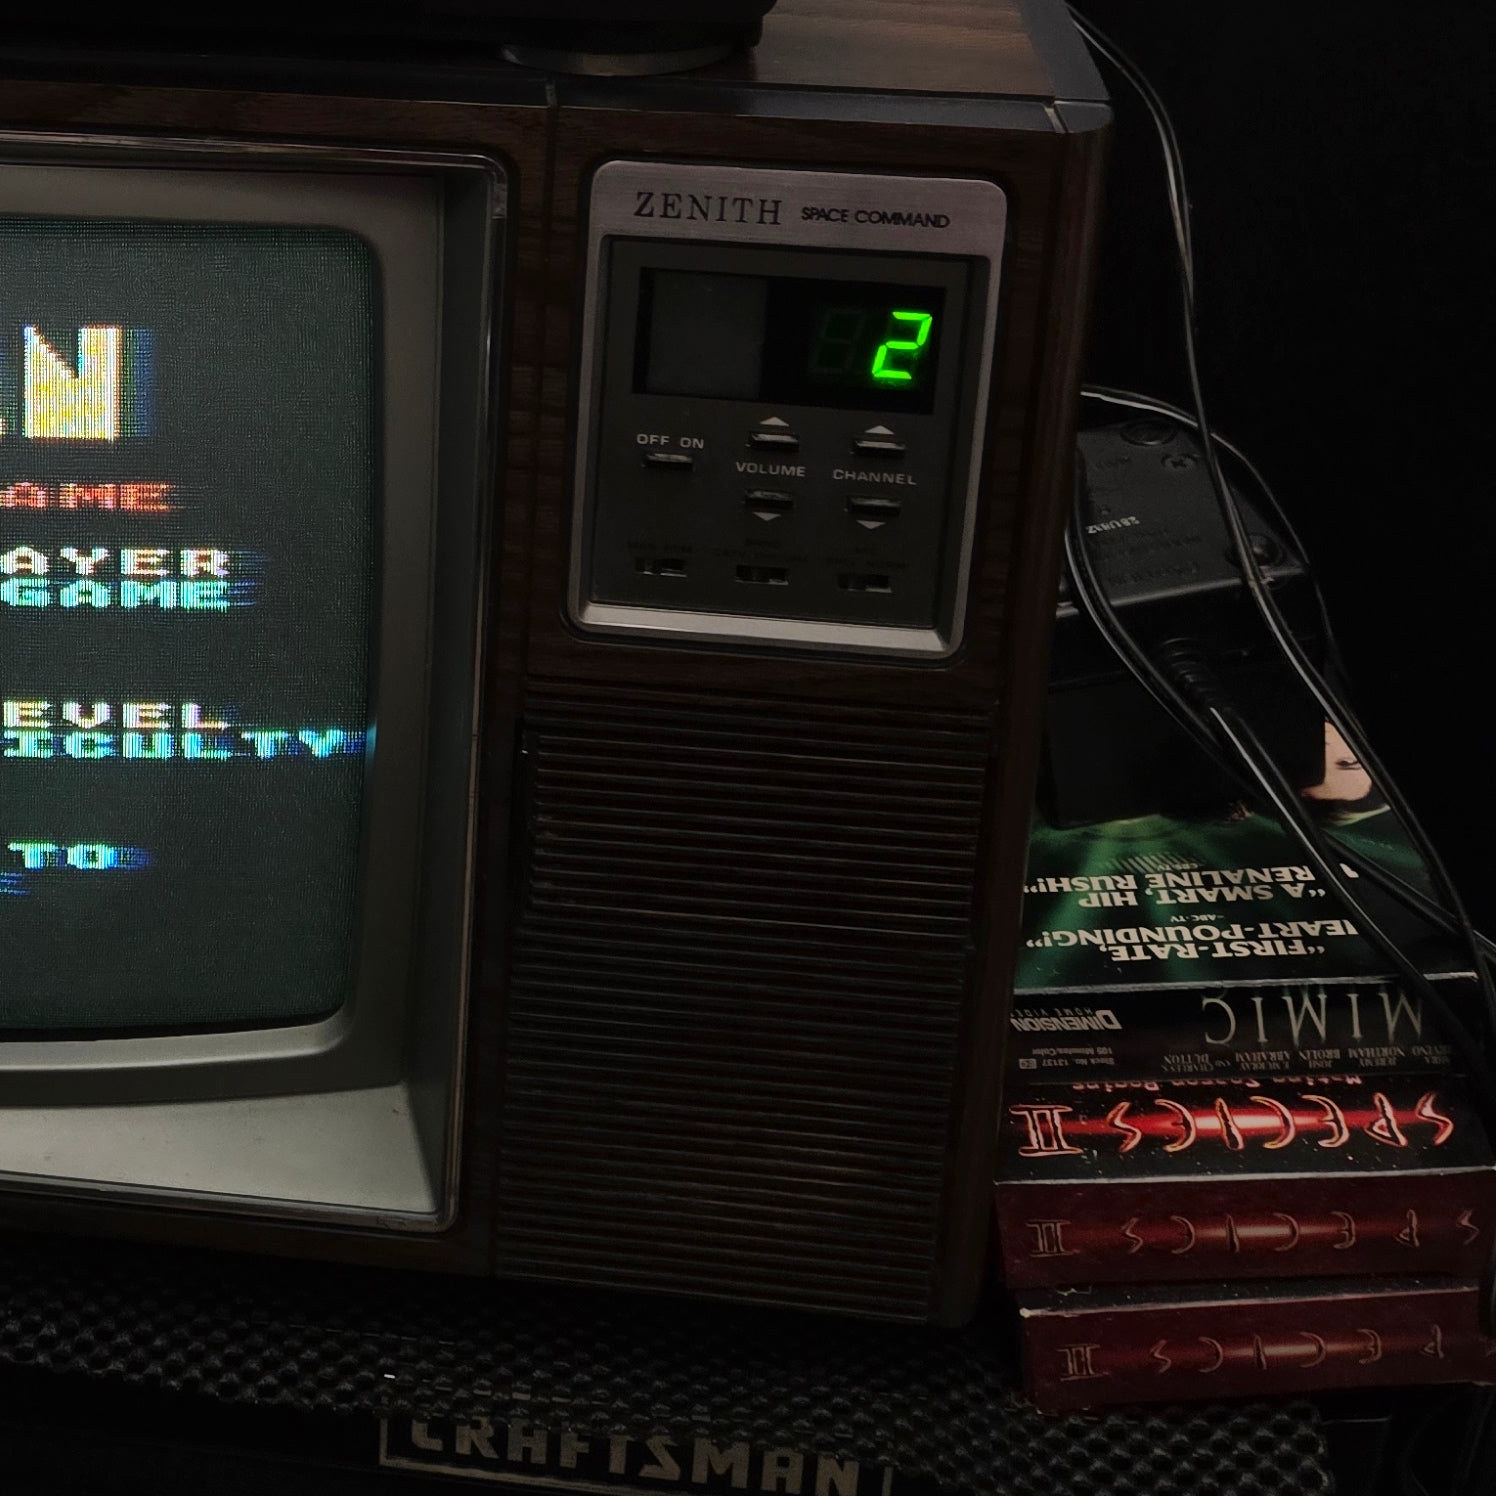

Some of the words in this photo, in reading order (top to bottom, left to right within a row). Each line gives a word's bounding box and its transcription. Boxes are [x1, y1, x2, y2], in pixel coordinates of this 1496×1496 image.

[634, 190, 782, 226] ZENITH
[801, 206, 850, 223] SPACE
[854, 209, 951, 229] COMMAND
[871, 311, 933, 381] 2
[636, 433, 671, 446] OFF
[679, 435, 705, 450] ON
[735, 461, 806, 478] VOLUME
[832, 468, 918, 486] CHANNEL
[0, 575, 232, 611] GAME
[7, 840, 120, 870] TO
[1077, 889, 1140, 908] HIP
[1144, 885, 1275, 905] SMART,
[1010, 1009, 1123, 1032] DIMENSION
[1199, 993, 1424, 1047] MIMIC
[1009, 1104, 1084, 1158] II
[1105, 1091, 1455, 1154] SPECIES
[1025, 1217, 1081, 1259] II
[1117, 1207, 1480, 1255] SPECIES
[1054, 1342, 1108, 1382] II
[1150, 1324, 1445, 1373] PECIES
[410, 1415, 864, 1496] CRAFTSMAN
